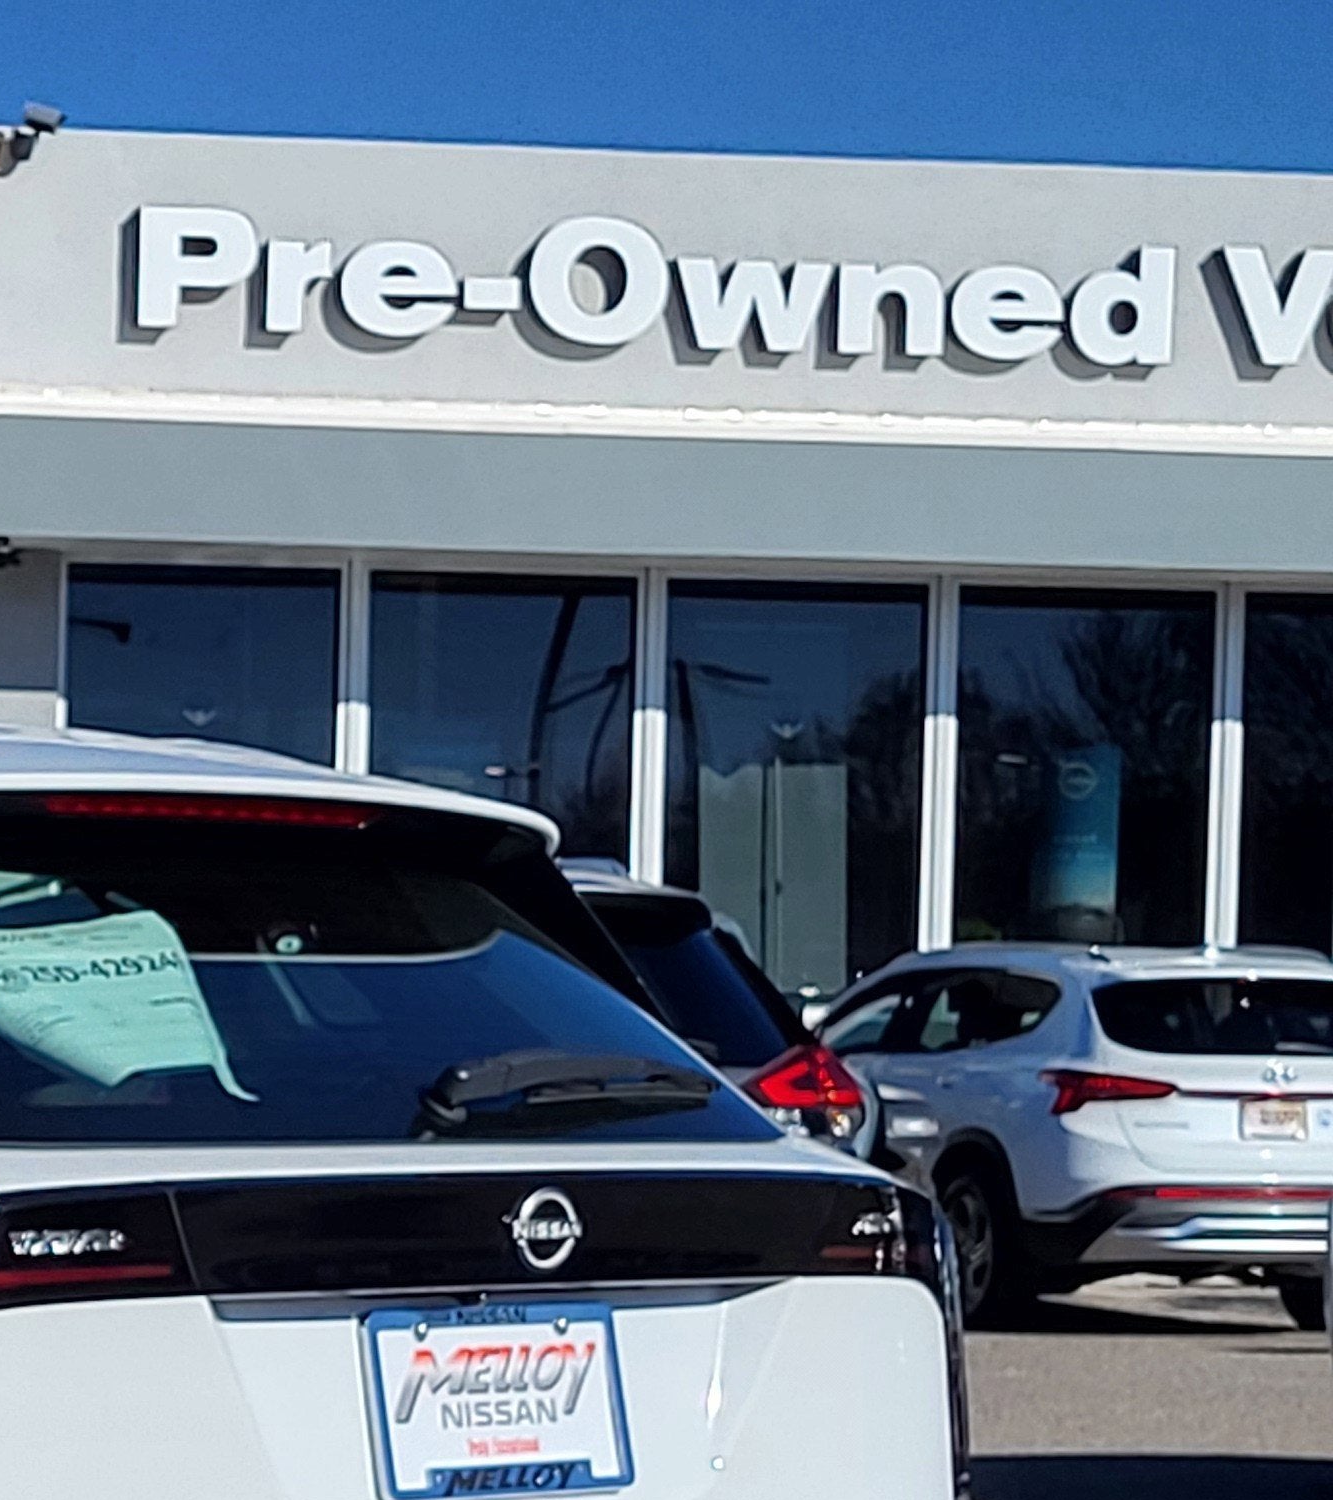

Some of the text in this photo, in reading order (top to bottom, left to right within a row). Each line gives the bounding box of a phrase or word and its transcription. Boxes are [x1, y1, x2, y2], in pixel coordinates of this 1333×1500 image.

[133, 203, 1333, 367] Pre-Owned V
[511, 1219, 584, 1241] NISSAN
[394, 1341, 596, 1424] MELLOY
[441, 1398, 558, 1429] NISSAN
[443, 1462, 576, 1496] MELLOY
